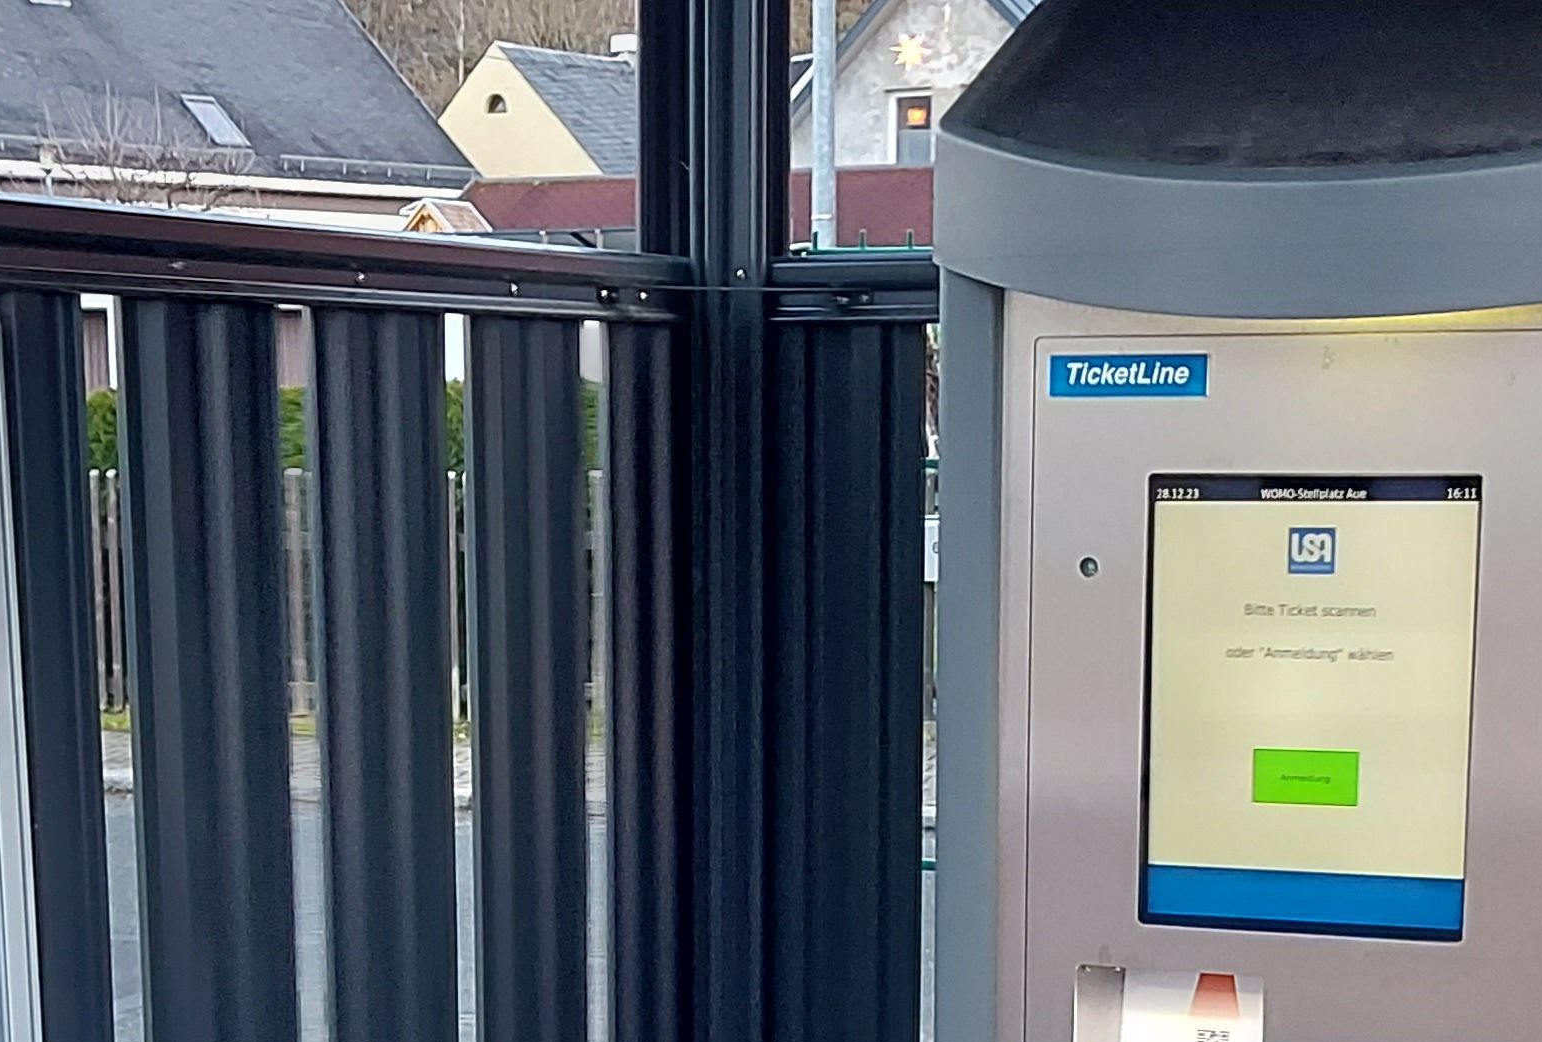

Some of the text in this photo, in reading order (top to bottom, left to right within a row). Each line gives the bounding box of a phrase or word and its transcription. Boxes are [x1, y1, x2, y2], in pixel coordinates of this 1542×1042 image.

[1066, 361, 1191, 386] TicketLine
[1446, 487, 1478, 499] 16:11
[1244, 603, 1377, 617] Bitte Ticket scannen
[1225, 646, 1255, 658] oder
[1347, 648, 1394, 661] wählen
